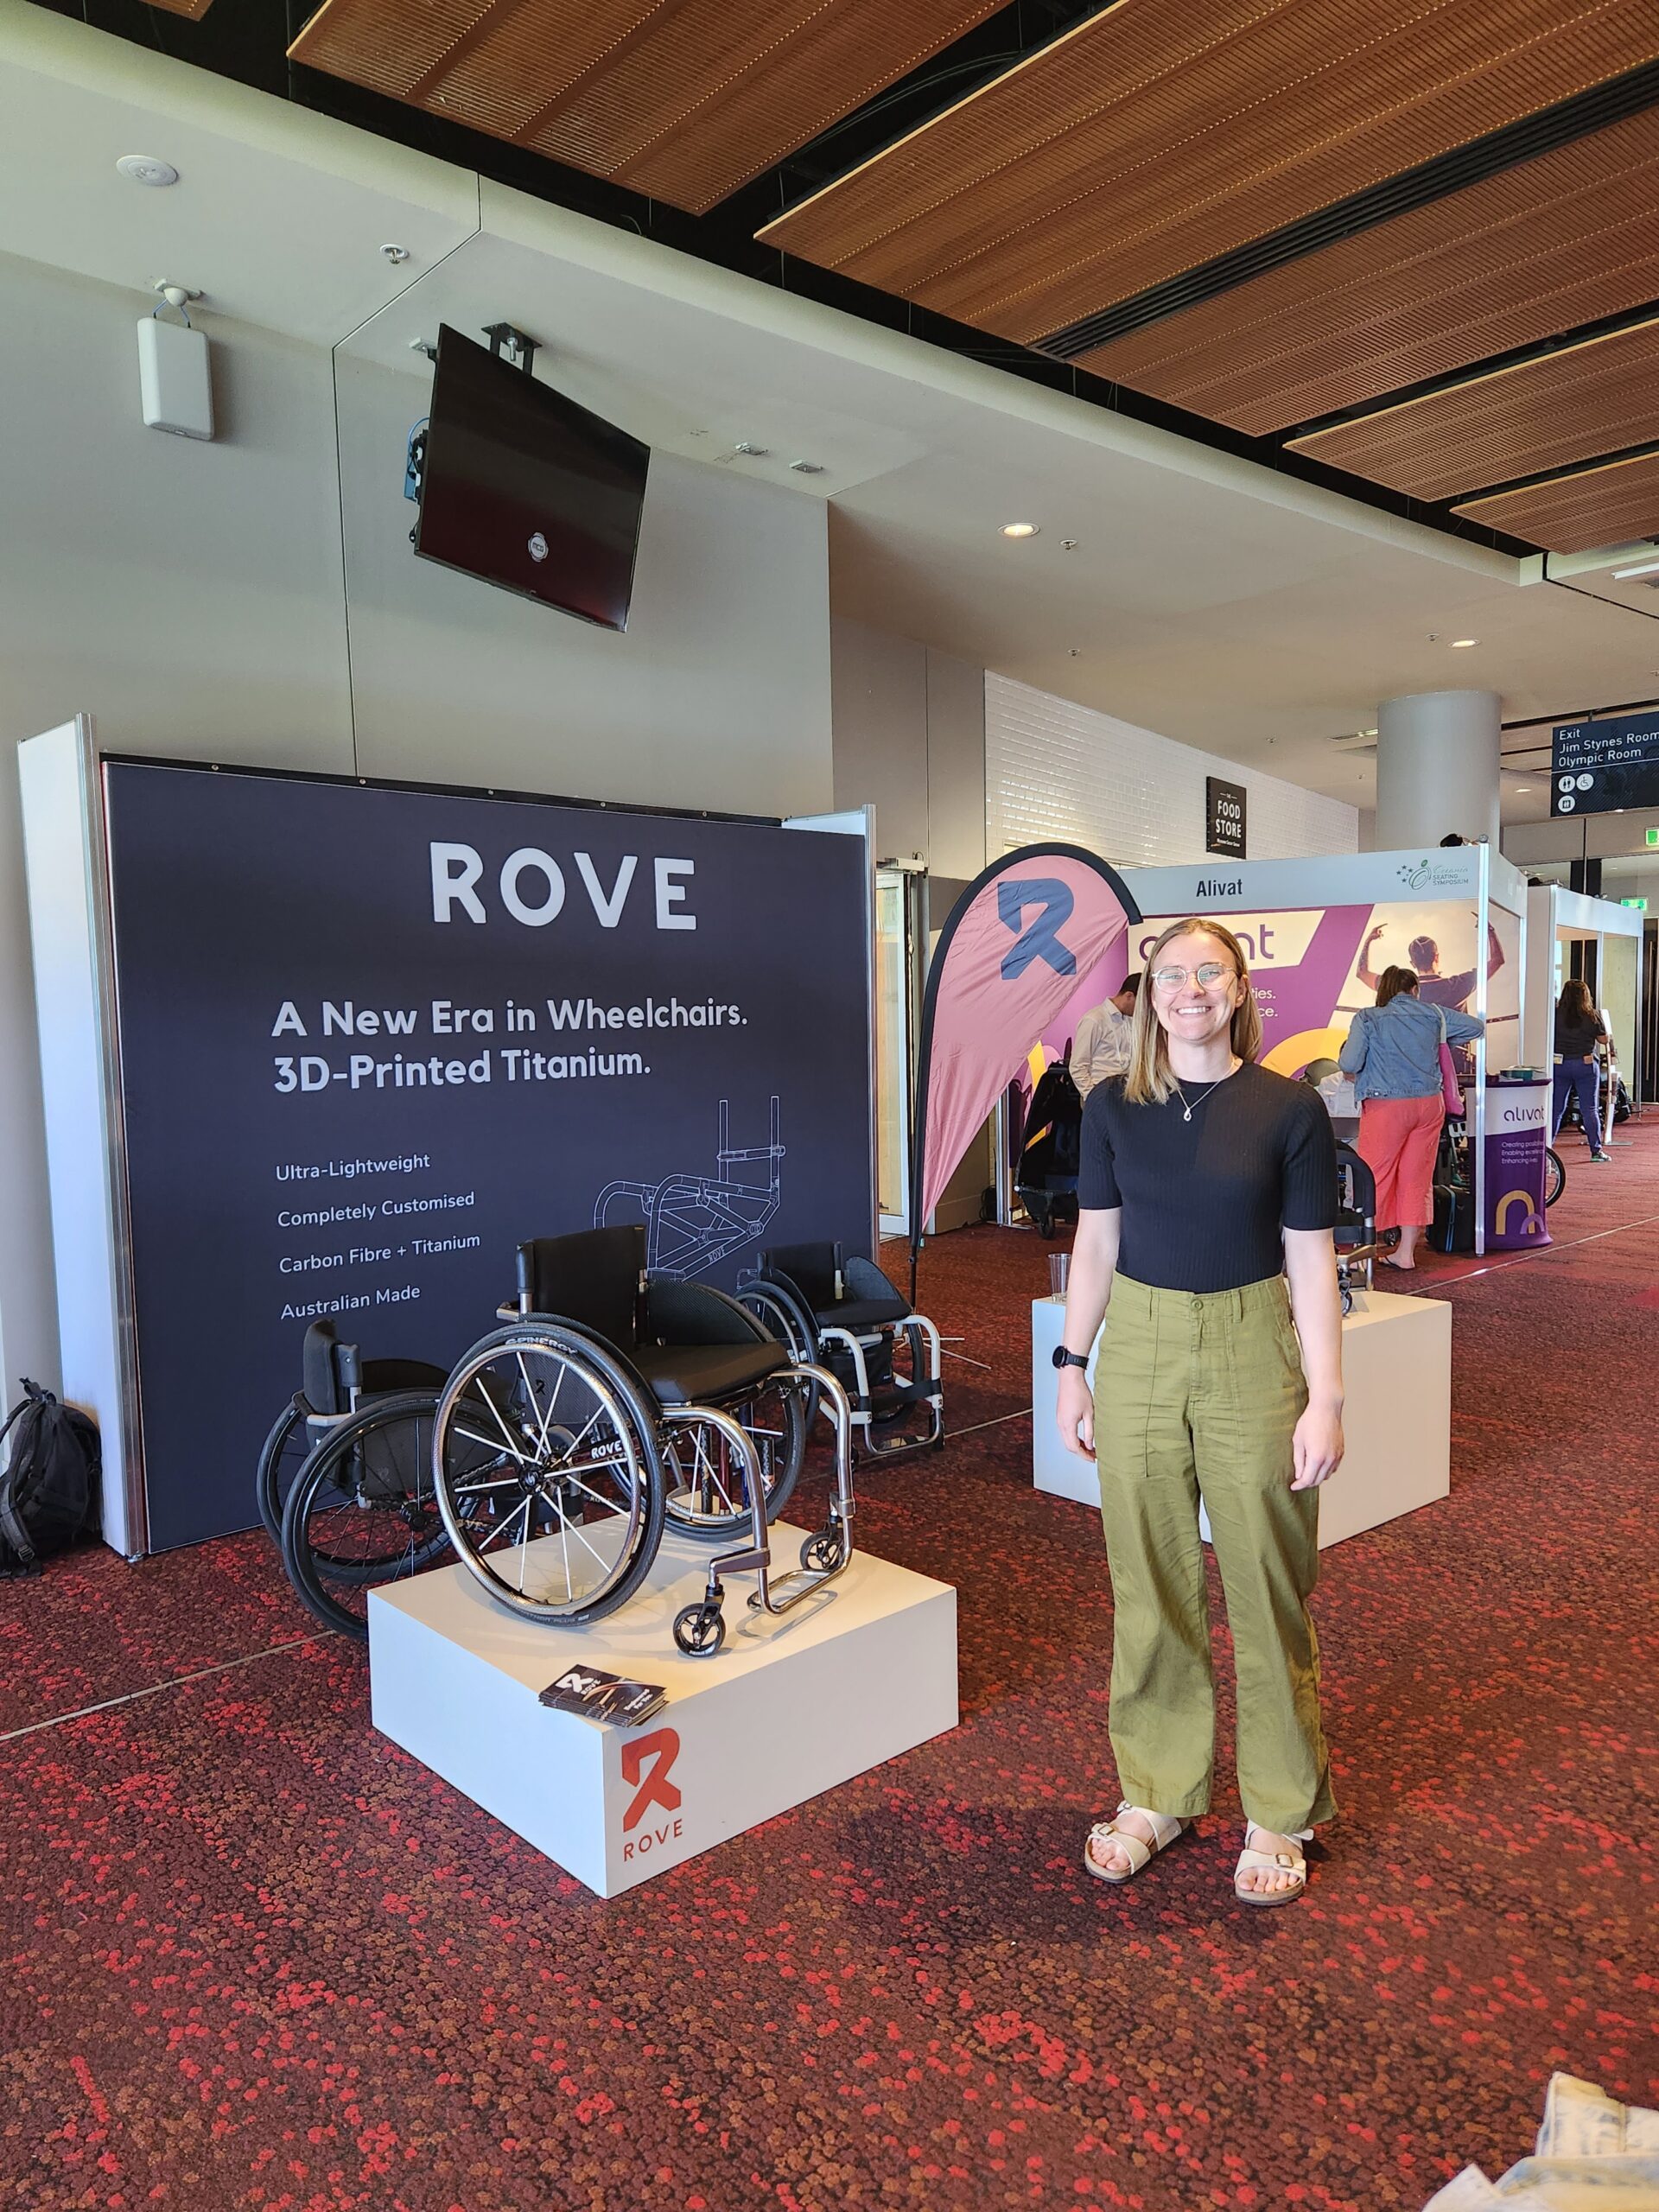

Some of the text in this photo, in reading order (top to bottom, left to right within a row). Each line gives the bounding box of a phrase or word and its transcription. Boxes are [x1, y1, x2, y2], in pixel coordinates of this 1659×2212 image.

[1559, 728, 1580, 741] Exit
[1559, 743, 1580, 754] Jim
[1584, 737, 1623, 751] Stynes
[1558, 748, 1642, 768] Olympic Room
[1217, 799, 1241, 819] FOOD
[1215, 818, 1242, 838] STORE
[429, 840, 697, 931] ROVE
[1195, 878, 1243, 898] Alivat
[270, 997, 748, 1038] A New Era in Wheelchairs.
[273, 1046, 652, 1093] 3D-Printed Titanium.
[276, 1154, 431, 1182] Ultra-Lightweight
[277, 1191, 475, 1227] Completely Customised
[279, 1234, 481, 1274] Carbon Fibre + Titanium
[708, 1246, 726, 1262] ROVE
[280, 1285, 422, 1320] Australian Made
[505, 1336, 578, 1355] SPINERGY
[591, 1440, 623, 1459] ROVE
[623, 1818, 683, 1863] ROVE
